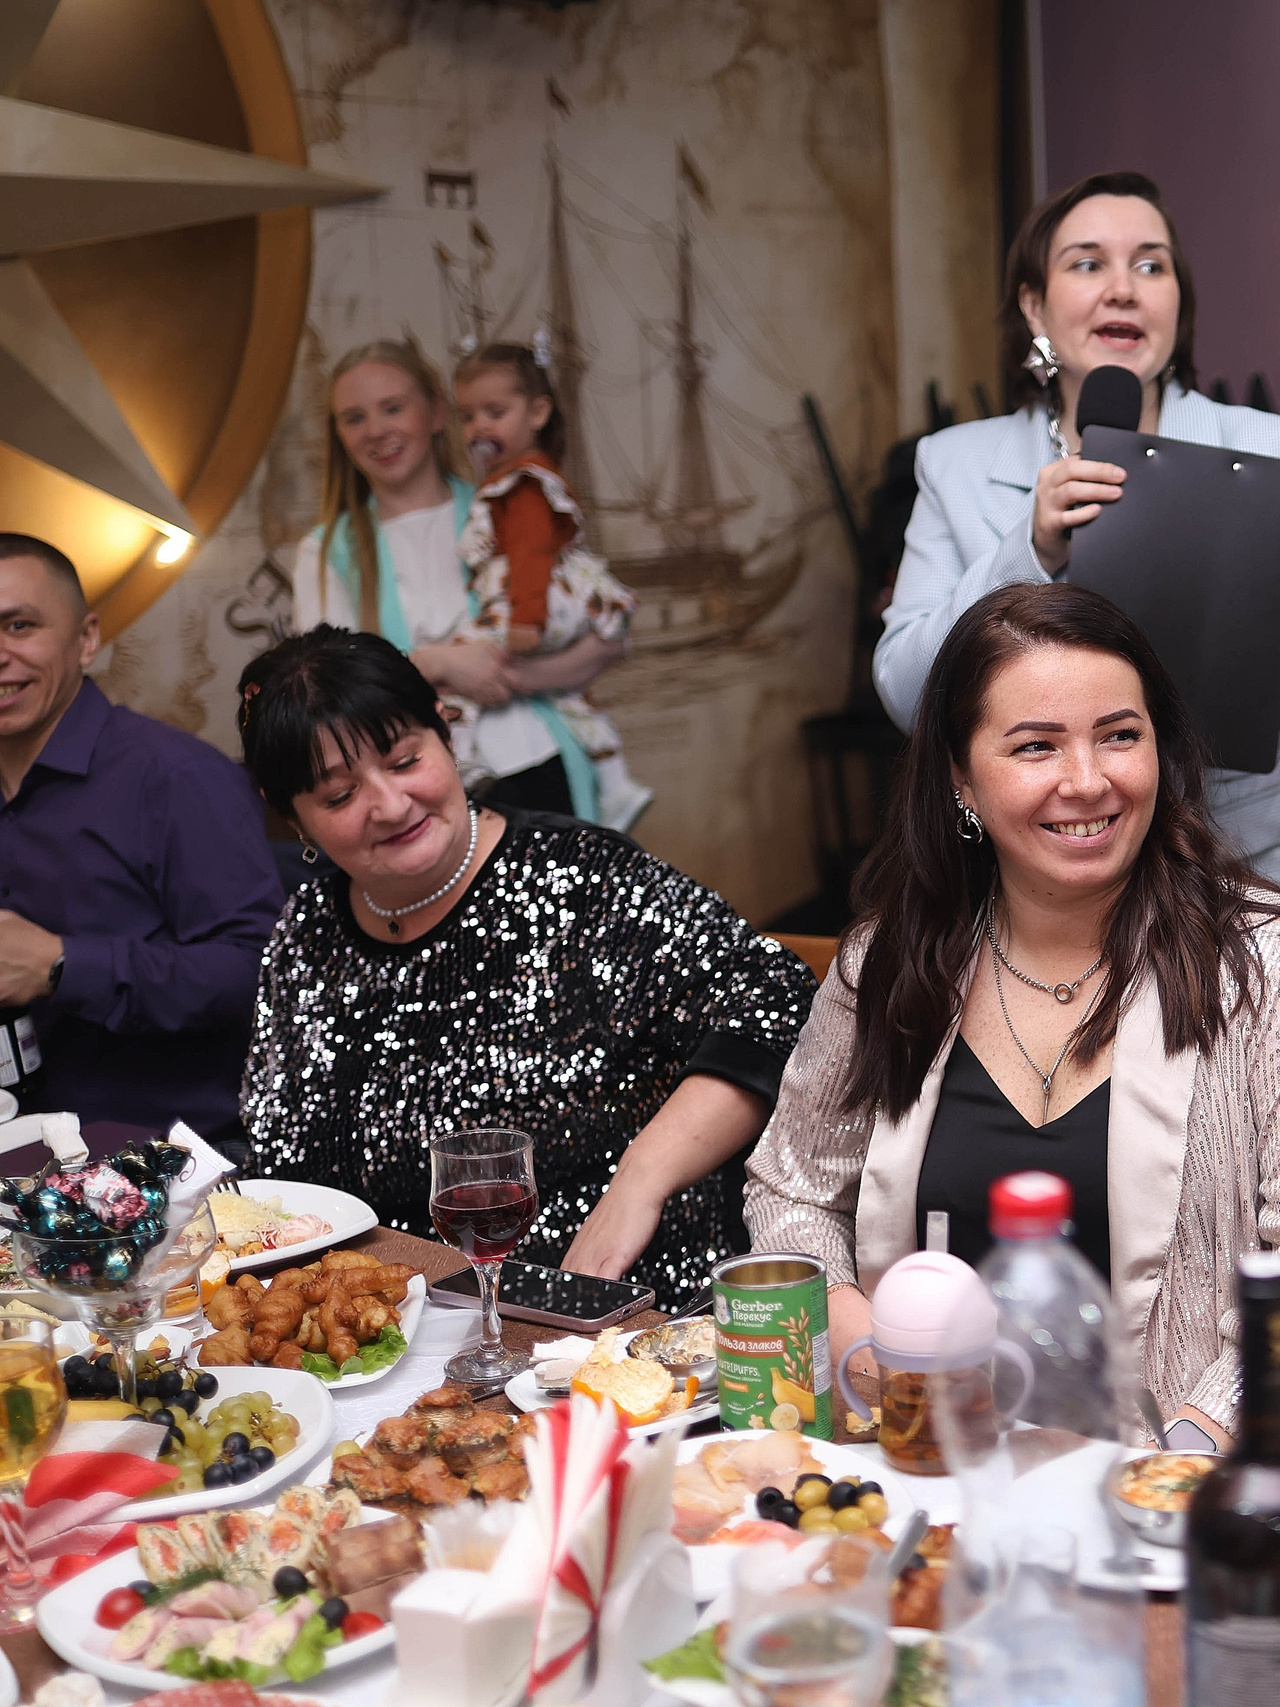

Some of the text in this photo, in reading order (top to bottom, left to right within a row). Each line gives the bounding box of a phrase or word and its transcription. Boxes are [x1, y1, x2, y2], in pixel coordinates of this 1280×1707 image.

[731, 1298, 782, 1312] Gerber
[732, 1310, 772, 1323] Перекус
[747, 1339, 783, 1351] злаков
